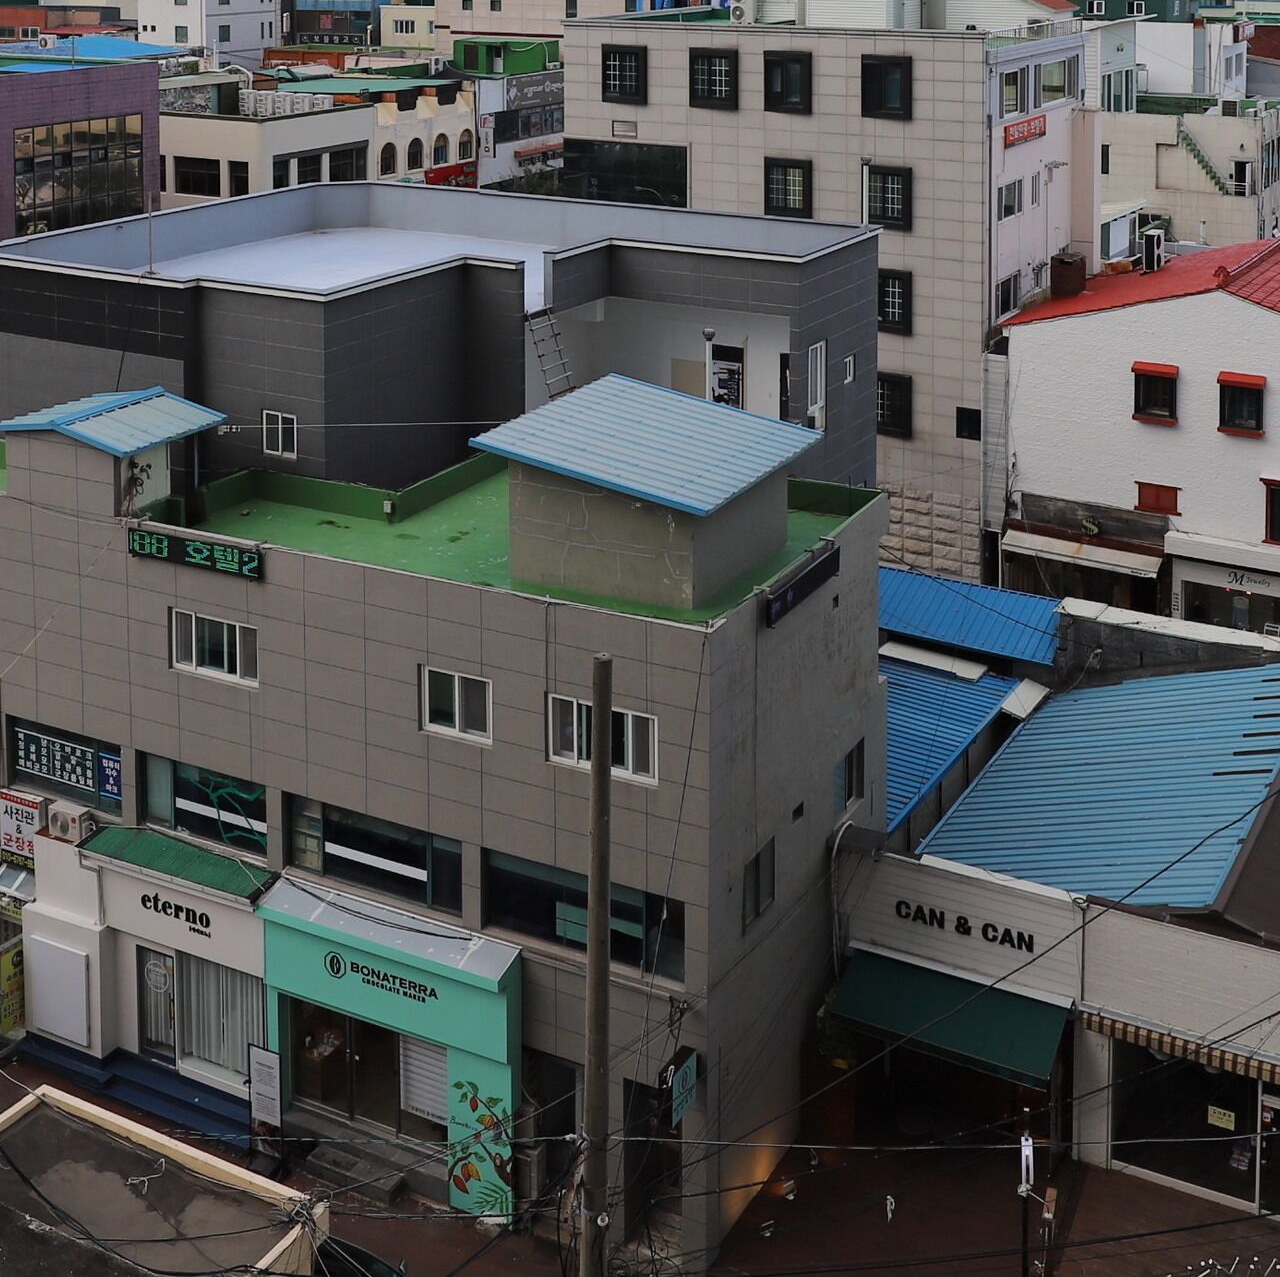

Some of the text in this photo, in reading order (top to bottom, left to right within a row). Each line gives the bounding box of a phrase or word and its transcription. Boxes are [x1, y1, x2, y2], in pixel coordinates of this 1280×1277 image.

[3, 804, 35, 826] 사진관
[15, 823, 23, 835] &
[140, 891, 212, 929] eterno
[895, 900, 1034, 953] CAN & CAN
[350, 961, 439, 1000] BONATERRA
[361, 976, 427, 1003] CHOCOLATE MAKER
